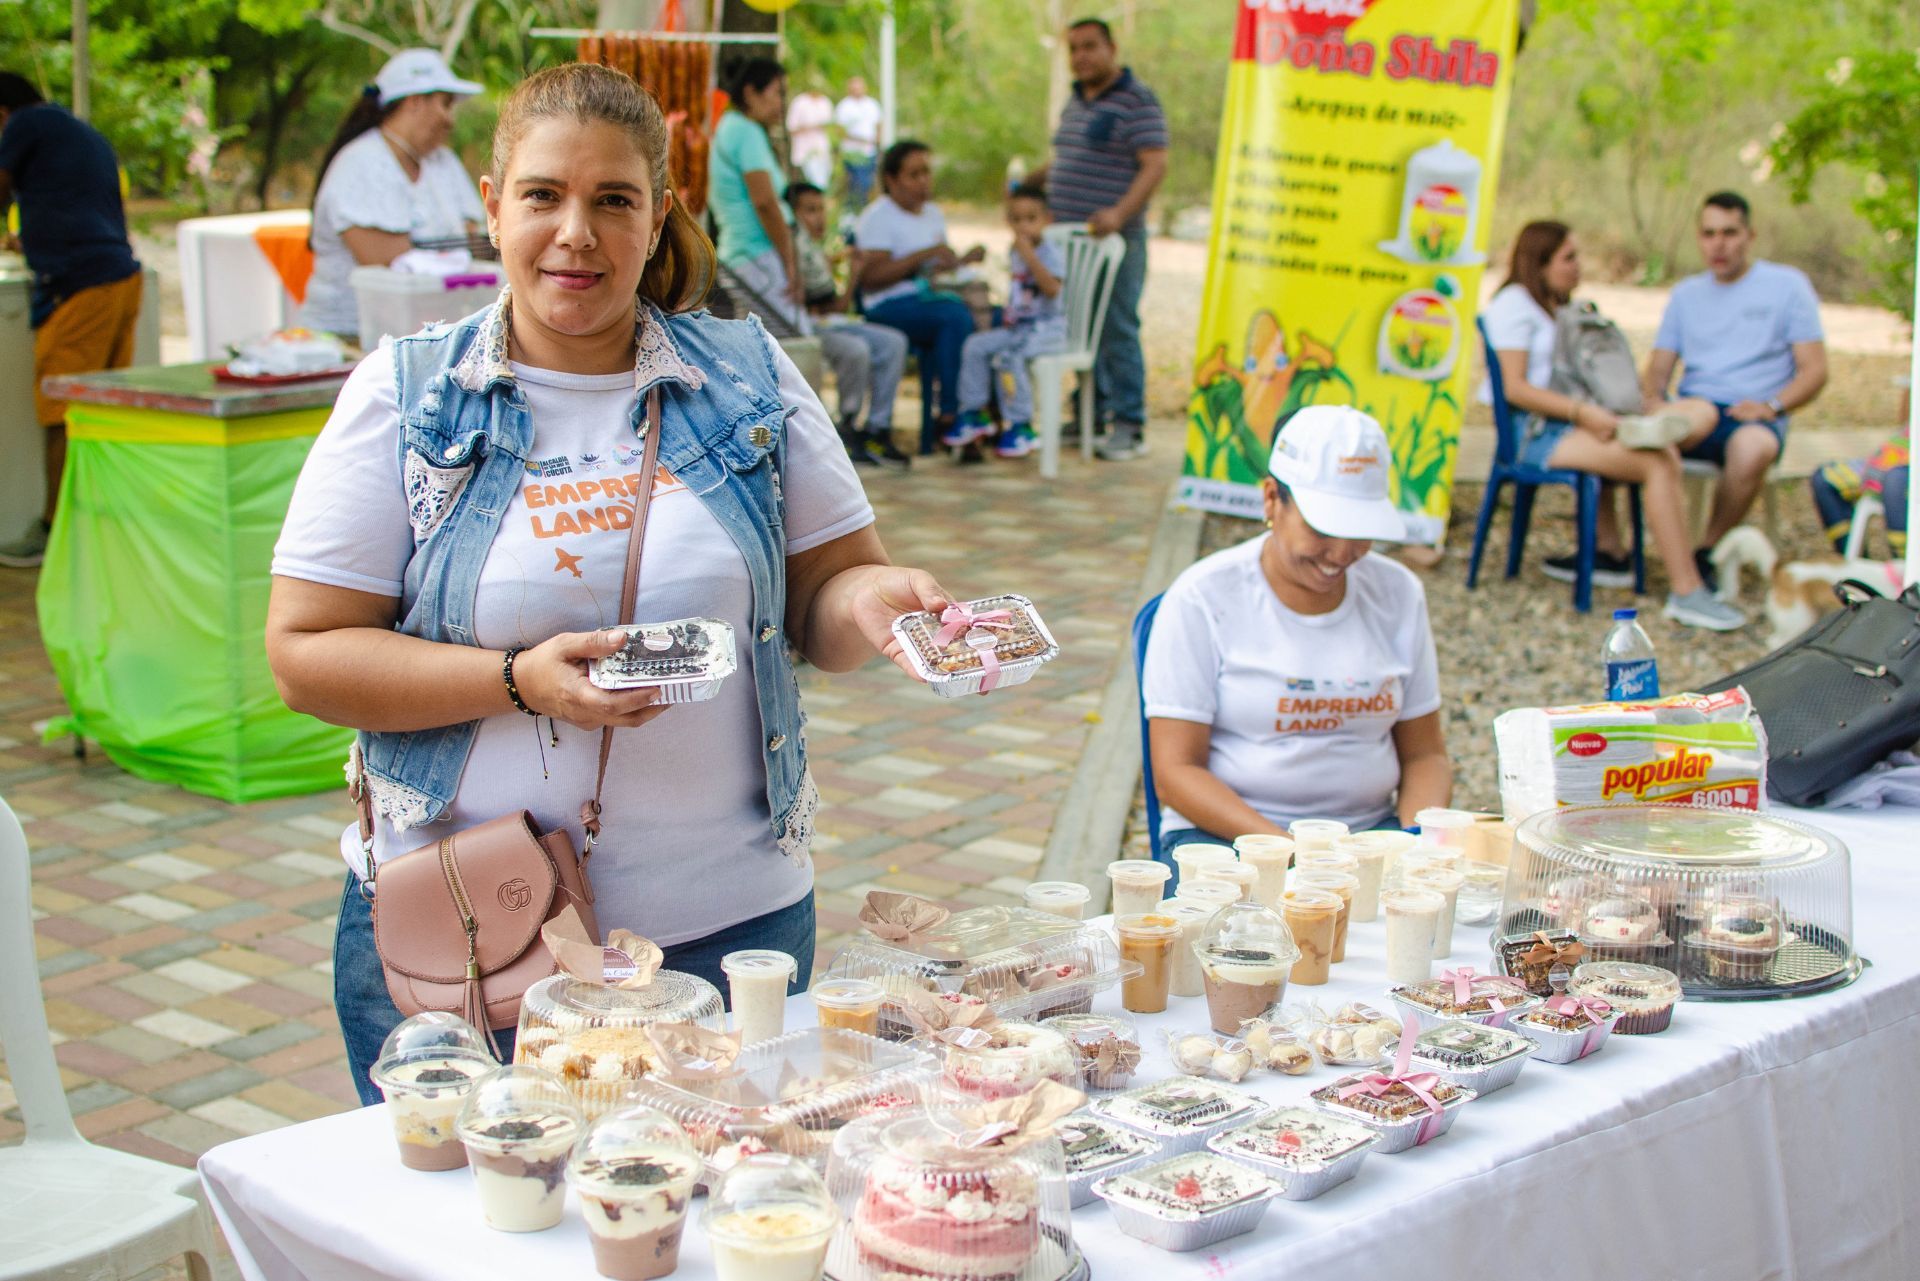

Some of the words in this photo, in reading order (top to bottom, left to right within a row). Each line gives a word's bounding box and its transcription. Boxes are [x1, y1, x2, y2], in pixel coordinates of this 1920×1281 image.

[1383, 32, 1499, 88] Shila
[1374, 99, 1398, 122] de
[530, 505, 635, 539] LAND
[1275, 717, 1338, 733] LAND
[1571, 739, 1602, 749] Nuevas
[1602, 747, 1713, 799] popular
[1692, 788, 1734, 807] 600
